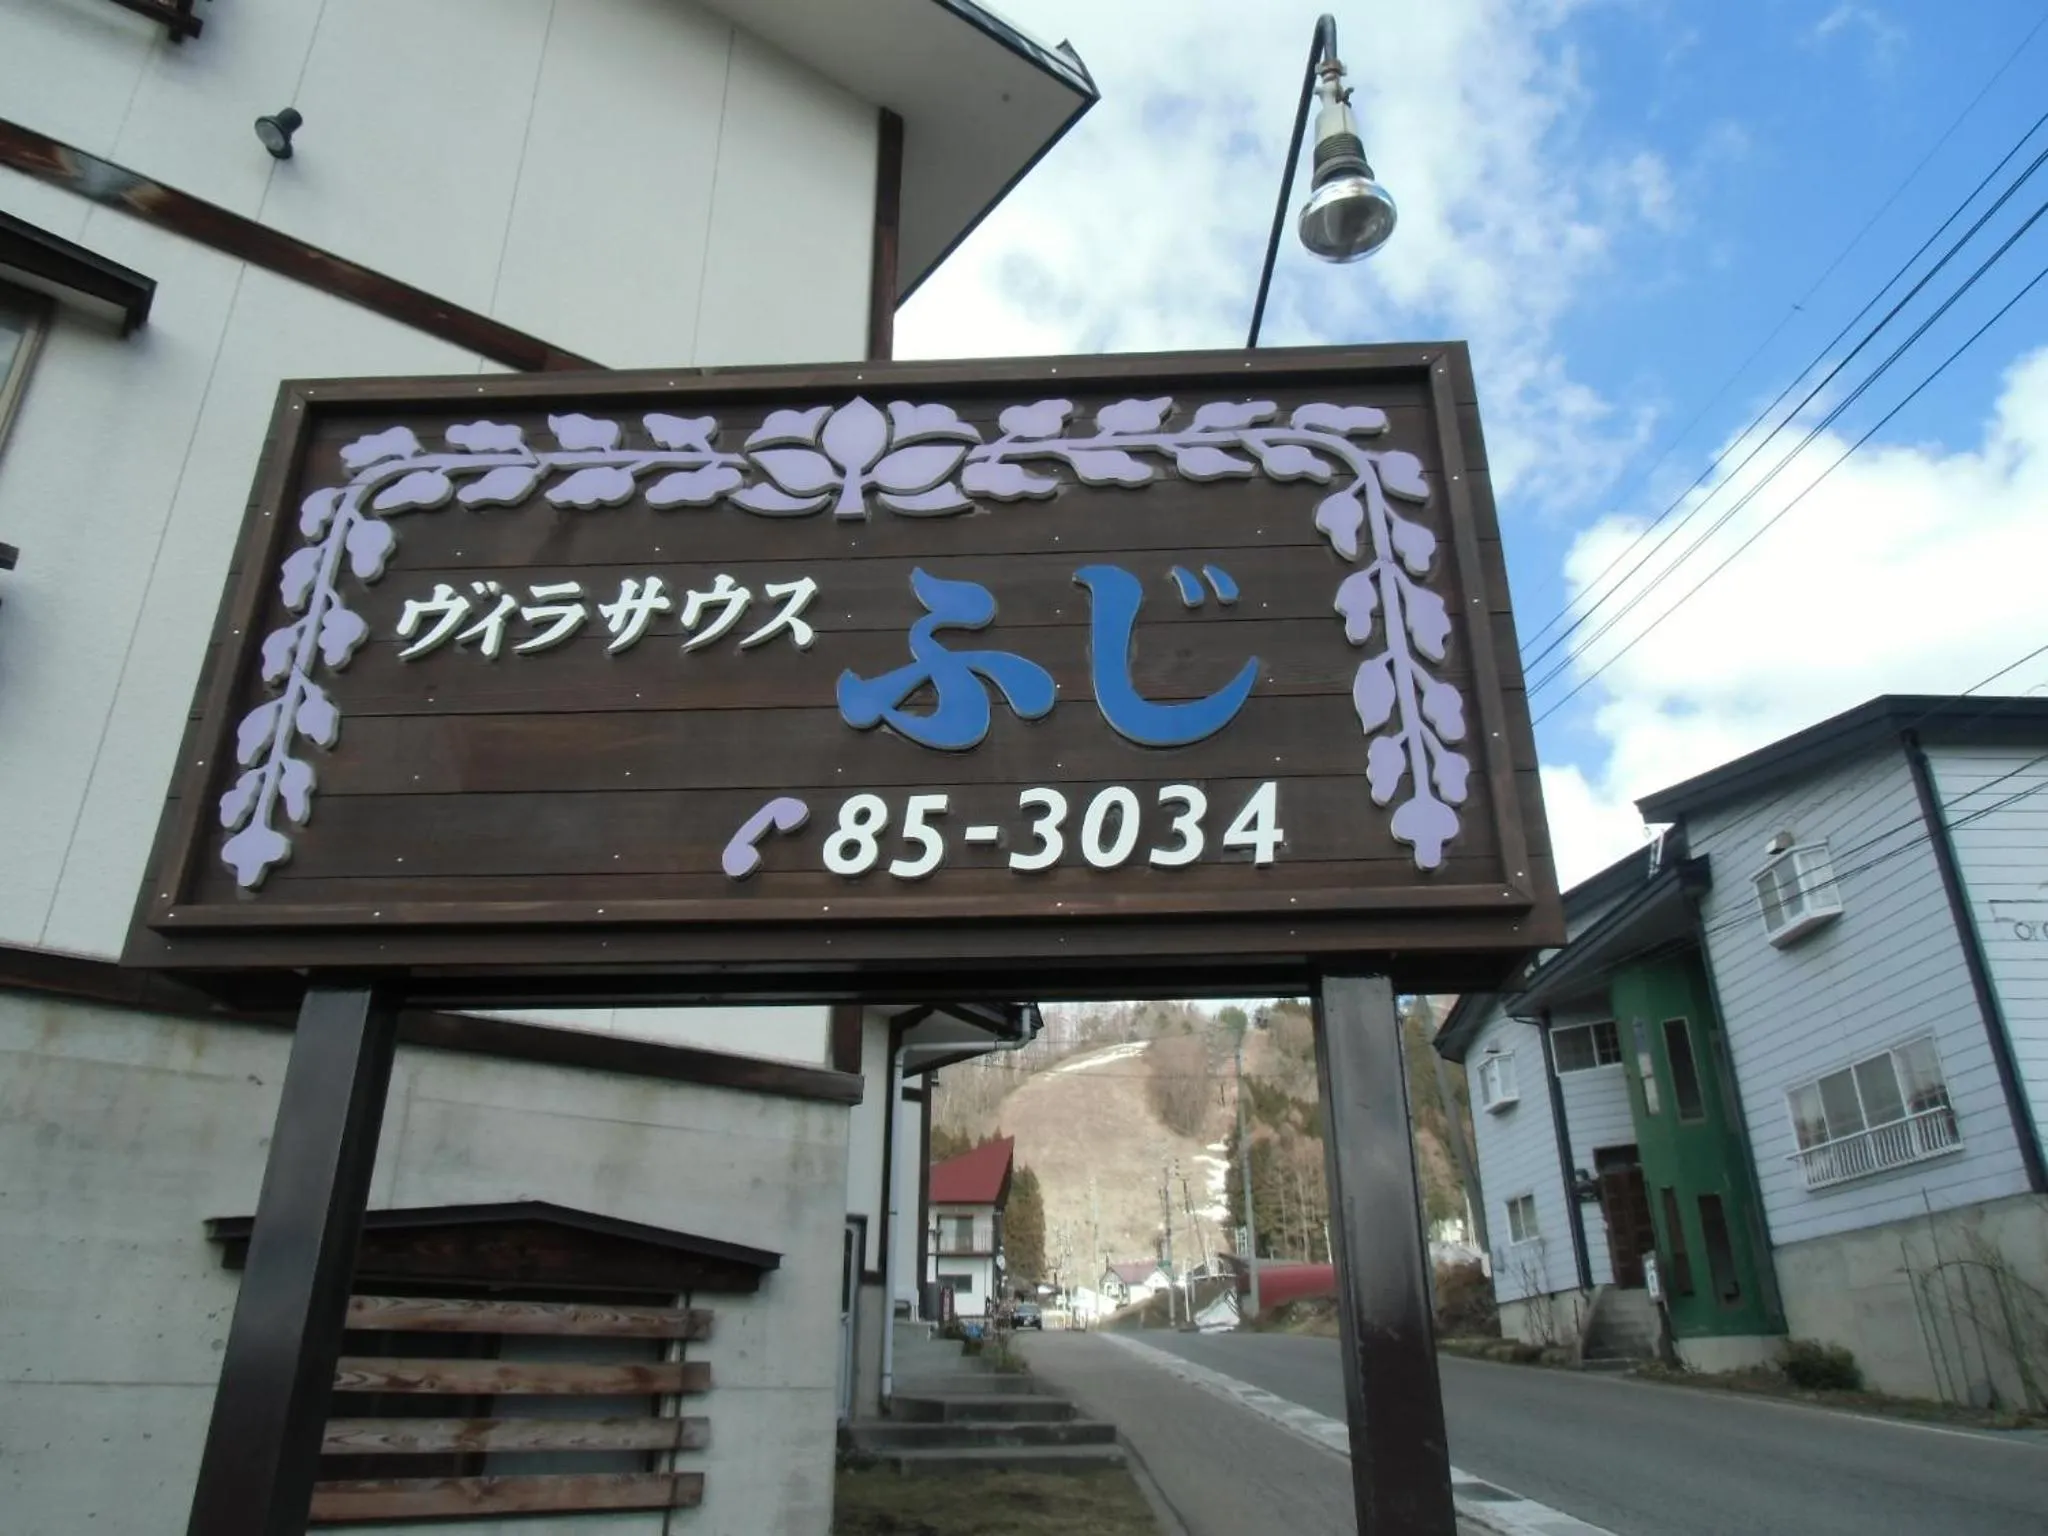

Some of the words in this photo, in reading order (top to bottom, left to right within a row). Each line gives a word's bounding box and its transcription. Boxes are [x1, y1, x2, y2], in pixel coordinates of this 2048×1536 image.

[396, 573, 819, 661] ヴィラサウス
[836, 564, 1260, 750] ふじ
[822, 780, 1285, 879] 85-3034
